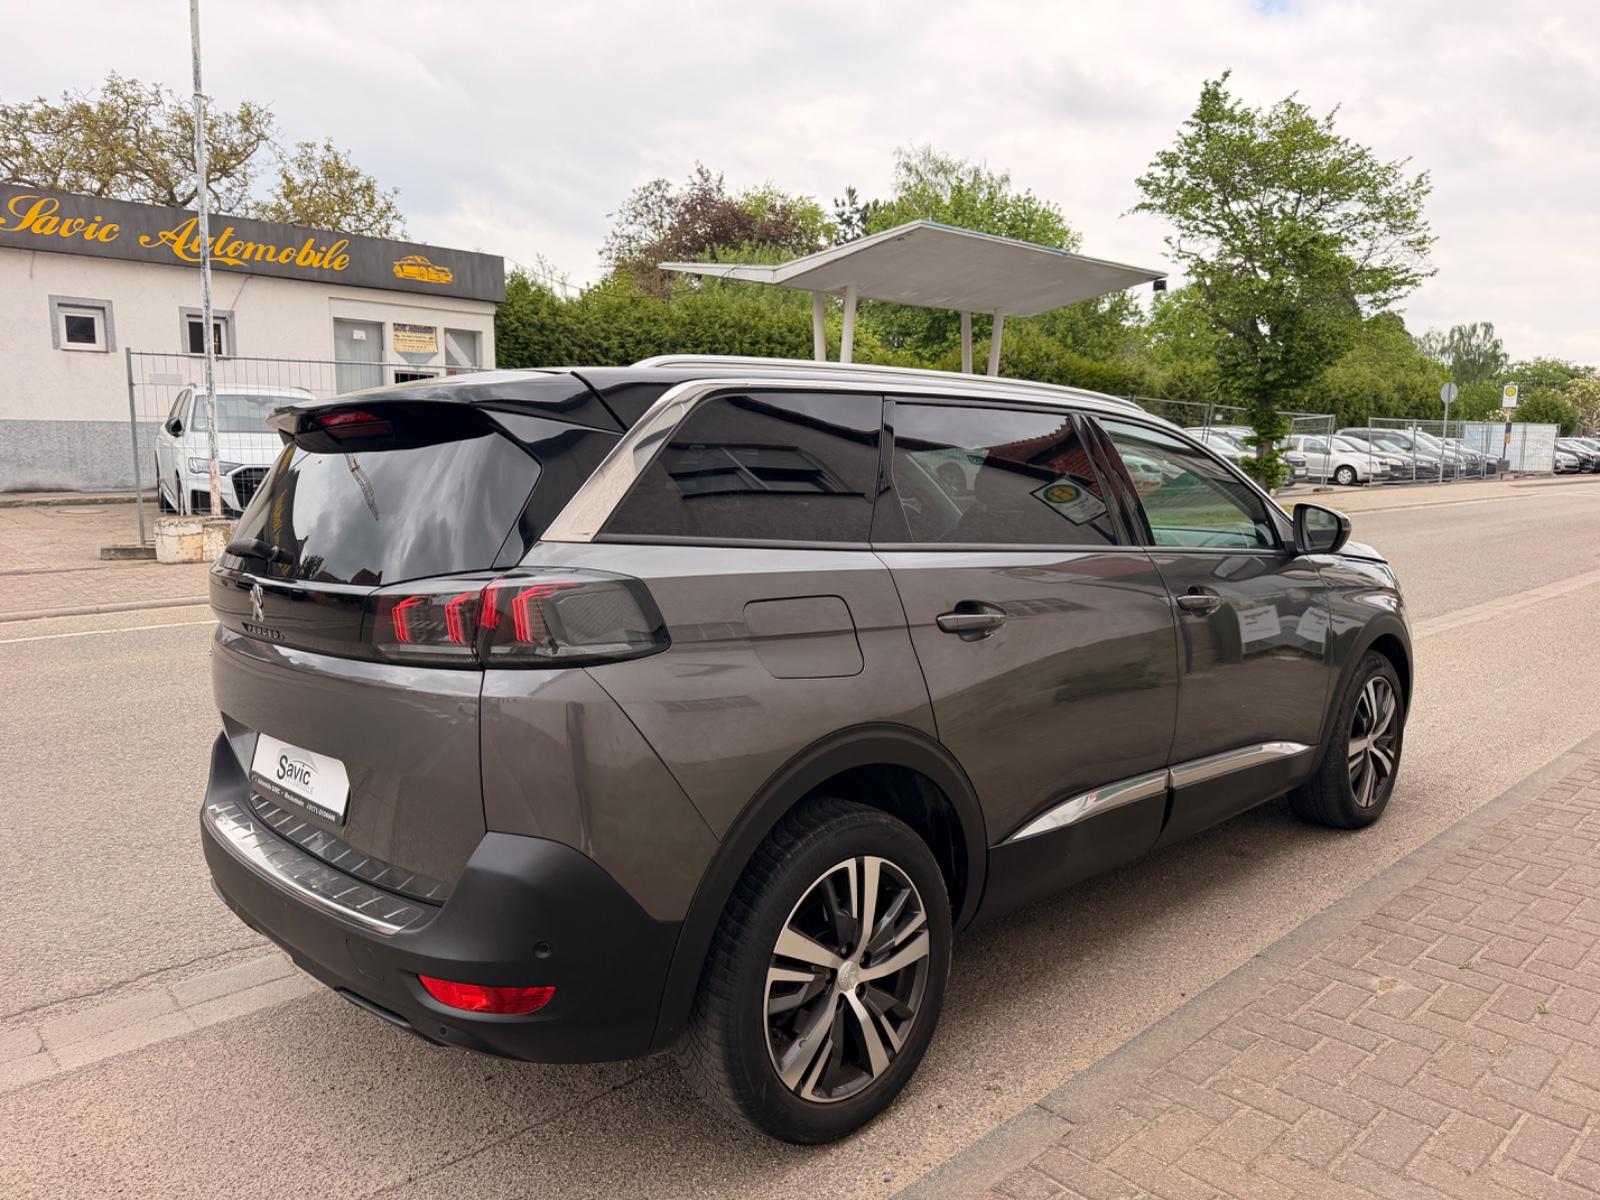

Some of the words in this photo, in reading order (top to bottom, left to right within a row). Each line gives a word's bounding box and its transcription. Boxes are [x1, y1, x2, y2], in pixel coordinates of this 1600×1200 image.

[0, 195, 120, 243] Savic
[139, 217, 350, 271] Automobile
[276, 754, 312, 786] Savic
